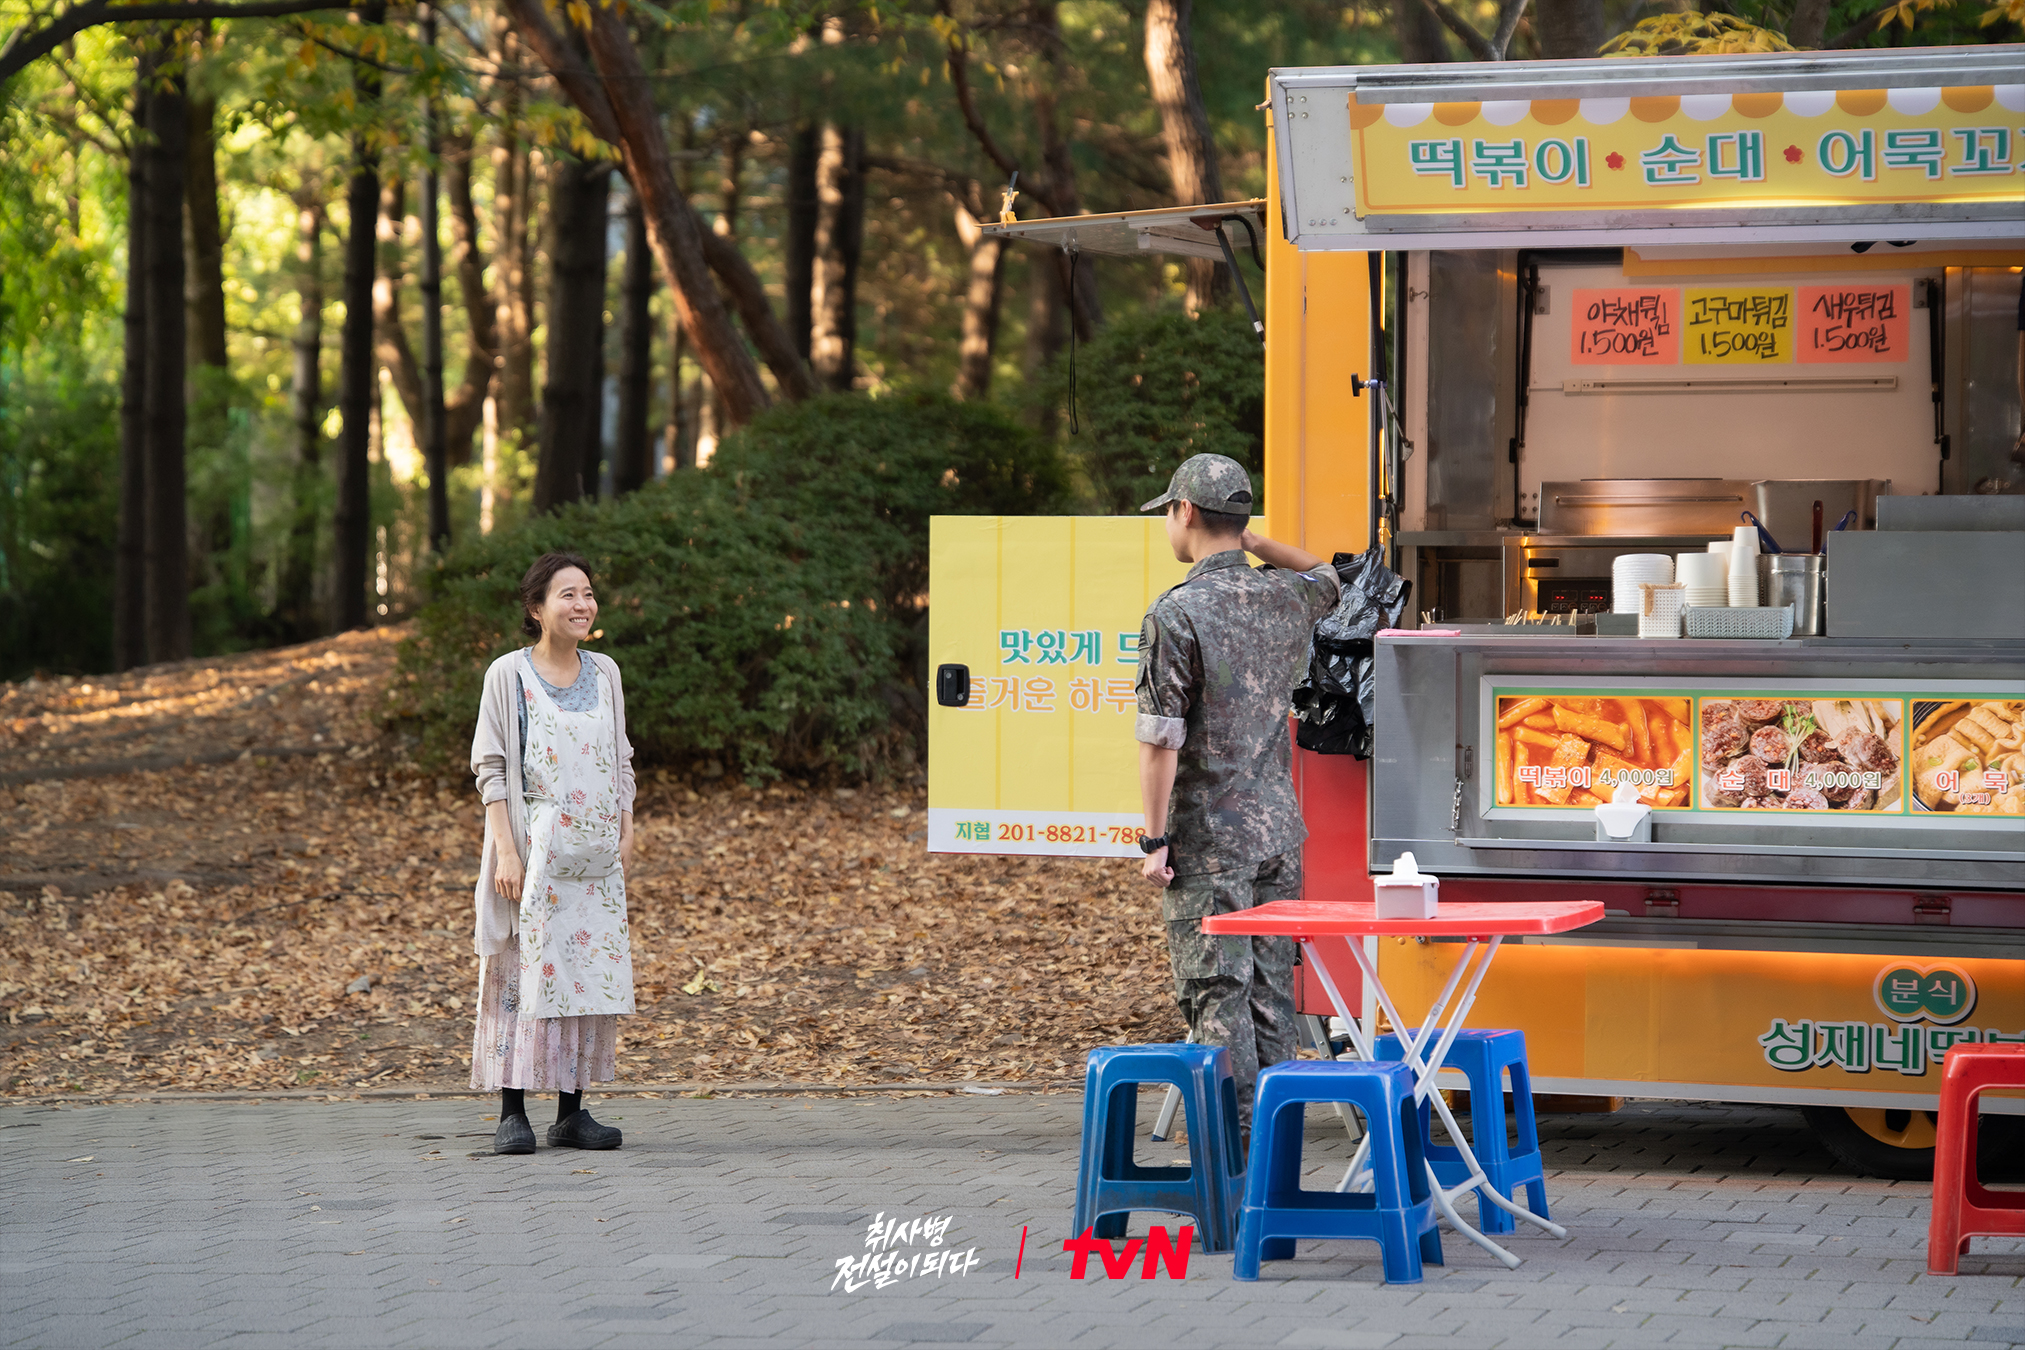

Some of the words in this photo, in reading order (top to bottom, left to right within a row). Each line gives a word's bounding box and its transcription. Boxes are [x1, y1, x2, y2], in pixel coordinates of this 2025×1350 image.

[1410, 138, 1591, 188] 떡볶이
[1642, 132, 1765, 184] 순대
[1818, 127, 2025, 180] 어묵꼬
[1587, 294, 1670, 336] 야채튀김
[1690, 293, 1789, 329] 고구마튀김
[1812, 290, 1897, 328] 새우튀김
[1581, 327, 1659, 356] 1.500원
[1701, 331, 1779, 359] 1.500원
[1814, 323, 1891, 353] 1.500원
[1000, 629, 1102, 666] 맛있게
[1519, 766, 1591, 788] 떡볶이
[1599, 768, 1675, 787] 4,000원
[1804, 771, 1882, 790] 4,000원
[1959, 793, 1991, 805] (3개)
[954, 821, 991, 841] 지협
